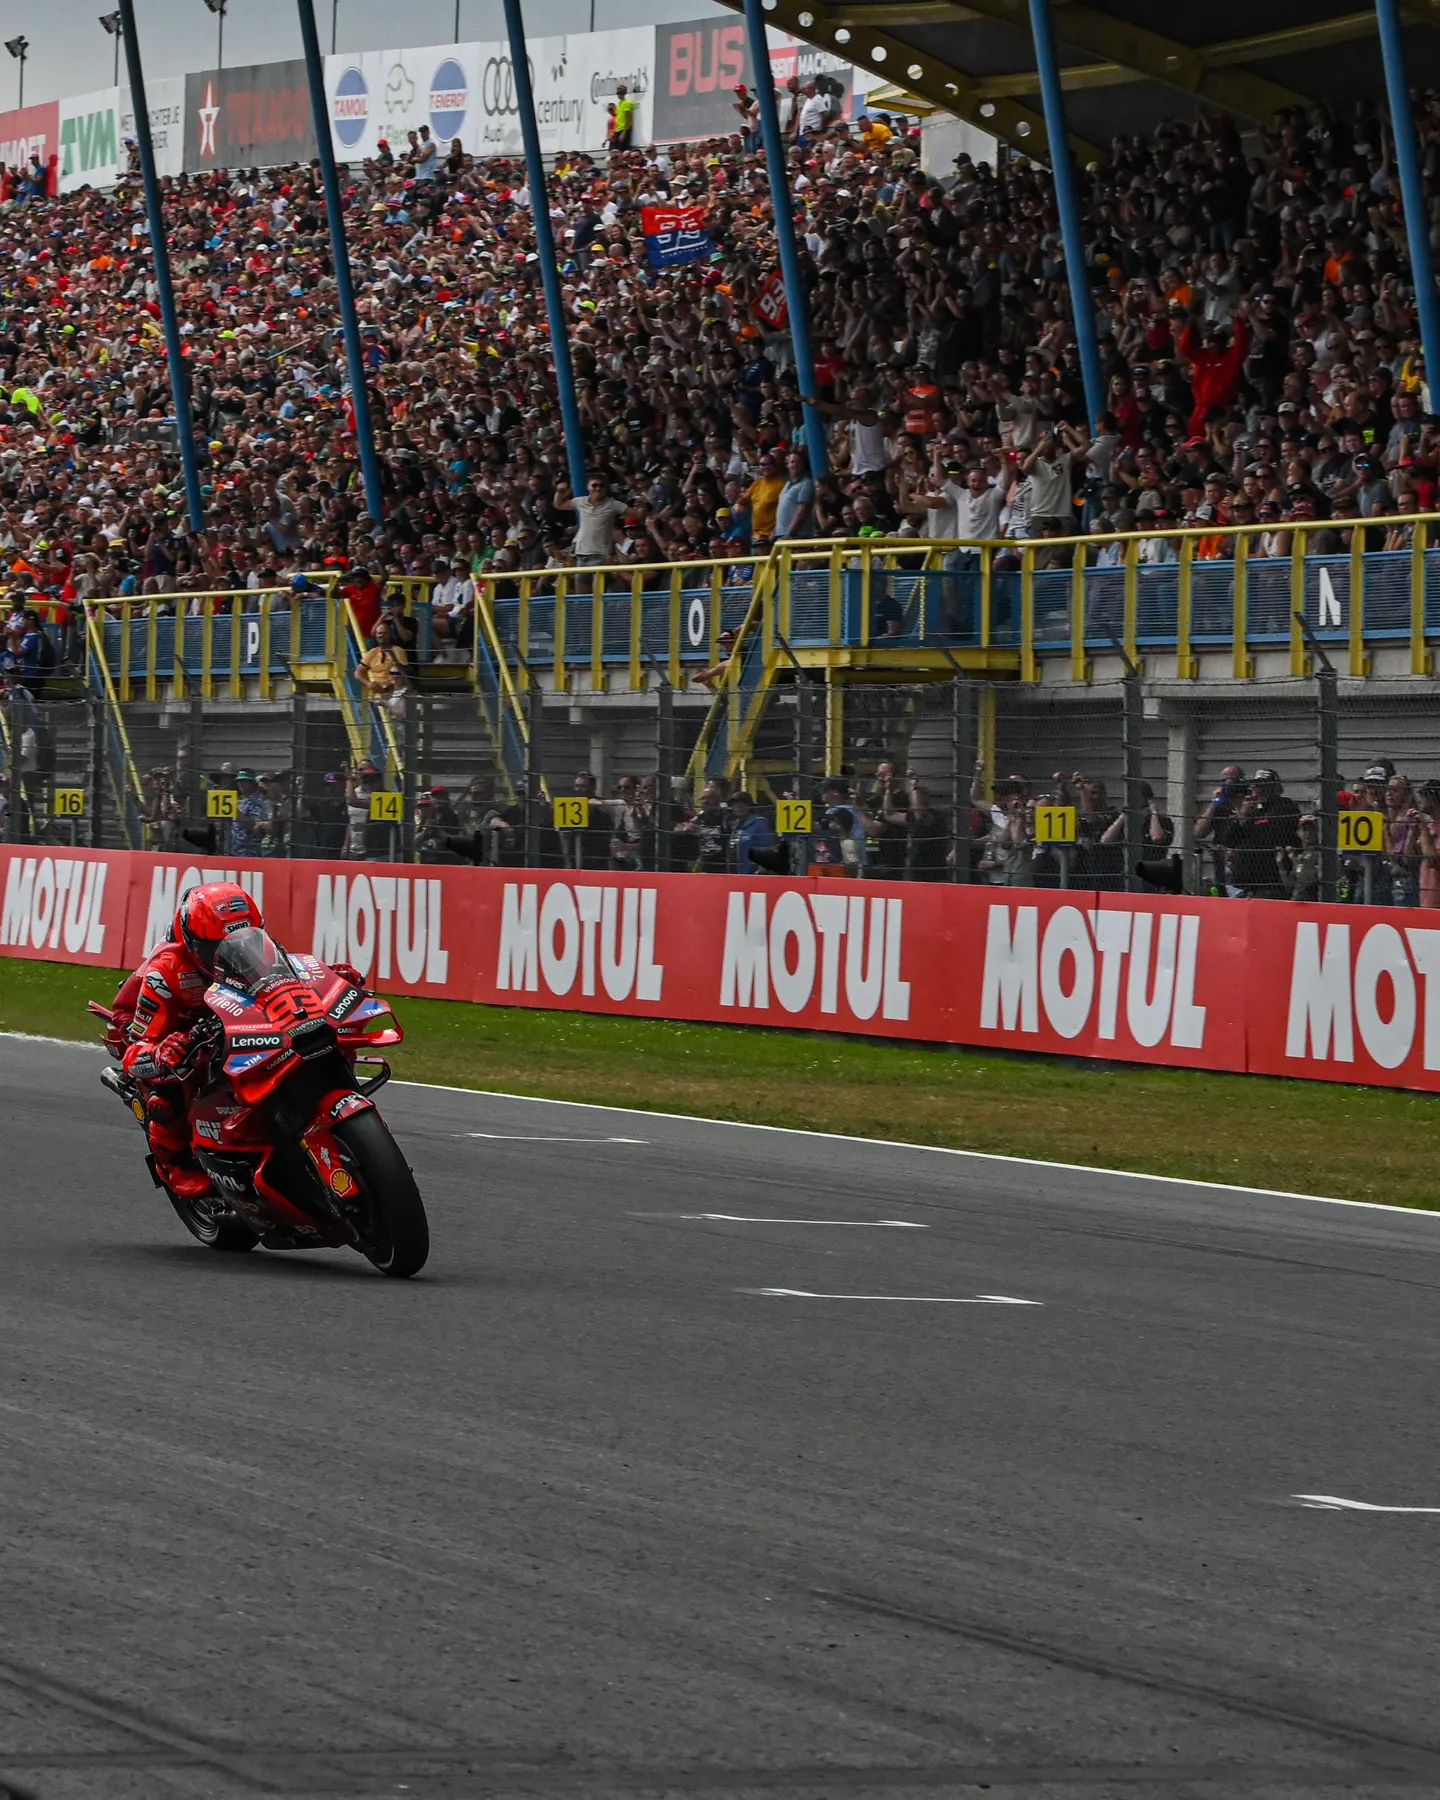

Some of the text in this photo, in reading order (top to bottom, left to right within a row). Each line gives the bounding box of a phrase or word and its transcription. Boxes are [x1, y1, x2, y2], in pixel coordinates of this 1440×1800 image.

[669, 25, 745, 97] BUS
[225, 85, 310, 147] TEXACO
[537, 95, 584, 135] century
[61, 108, 118, 176] TVM
[1318, 566, 1342, 627] N
[247, 621, 259, 664] P
[59, 792, 81, 813] 16
[212, 795, 233, 816] 15
[374, 796, 398, 819] 14
[560, 801, 584, 826] 13
[781, 804, 807, 830] 12
[1043, 811, 1069, 839] 11
[1340, 816, 1374, 846] 10
[0, 857, 108, 953] MOTUL
[312, 873, 449, 985] MOTUL
[496, 882, 663, 1001] MOTUL
[720, 890, 911, 1021] MOTUL
[225, 977, 246, 990] WRS
[980, 904, 1207, 1049] MOTUL
[265, 986, 325, 1025] 93
[328, 988, 358, 1020] Lenovo
[1285, 921, 1440, 1071] MOT
[135, 1008, 153, 1023] ba.it
[364, 1008, 384, 1016] TIM
[232, 1036, 280, 1048] Lenovo
[243, 1054, 263, 1067] TIM
[266, 1048, 295, 1070] CARRERA
[215, 1106, 242, 1116] DUCAT
